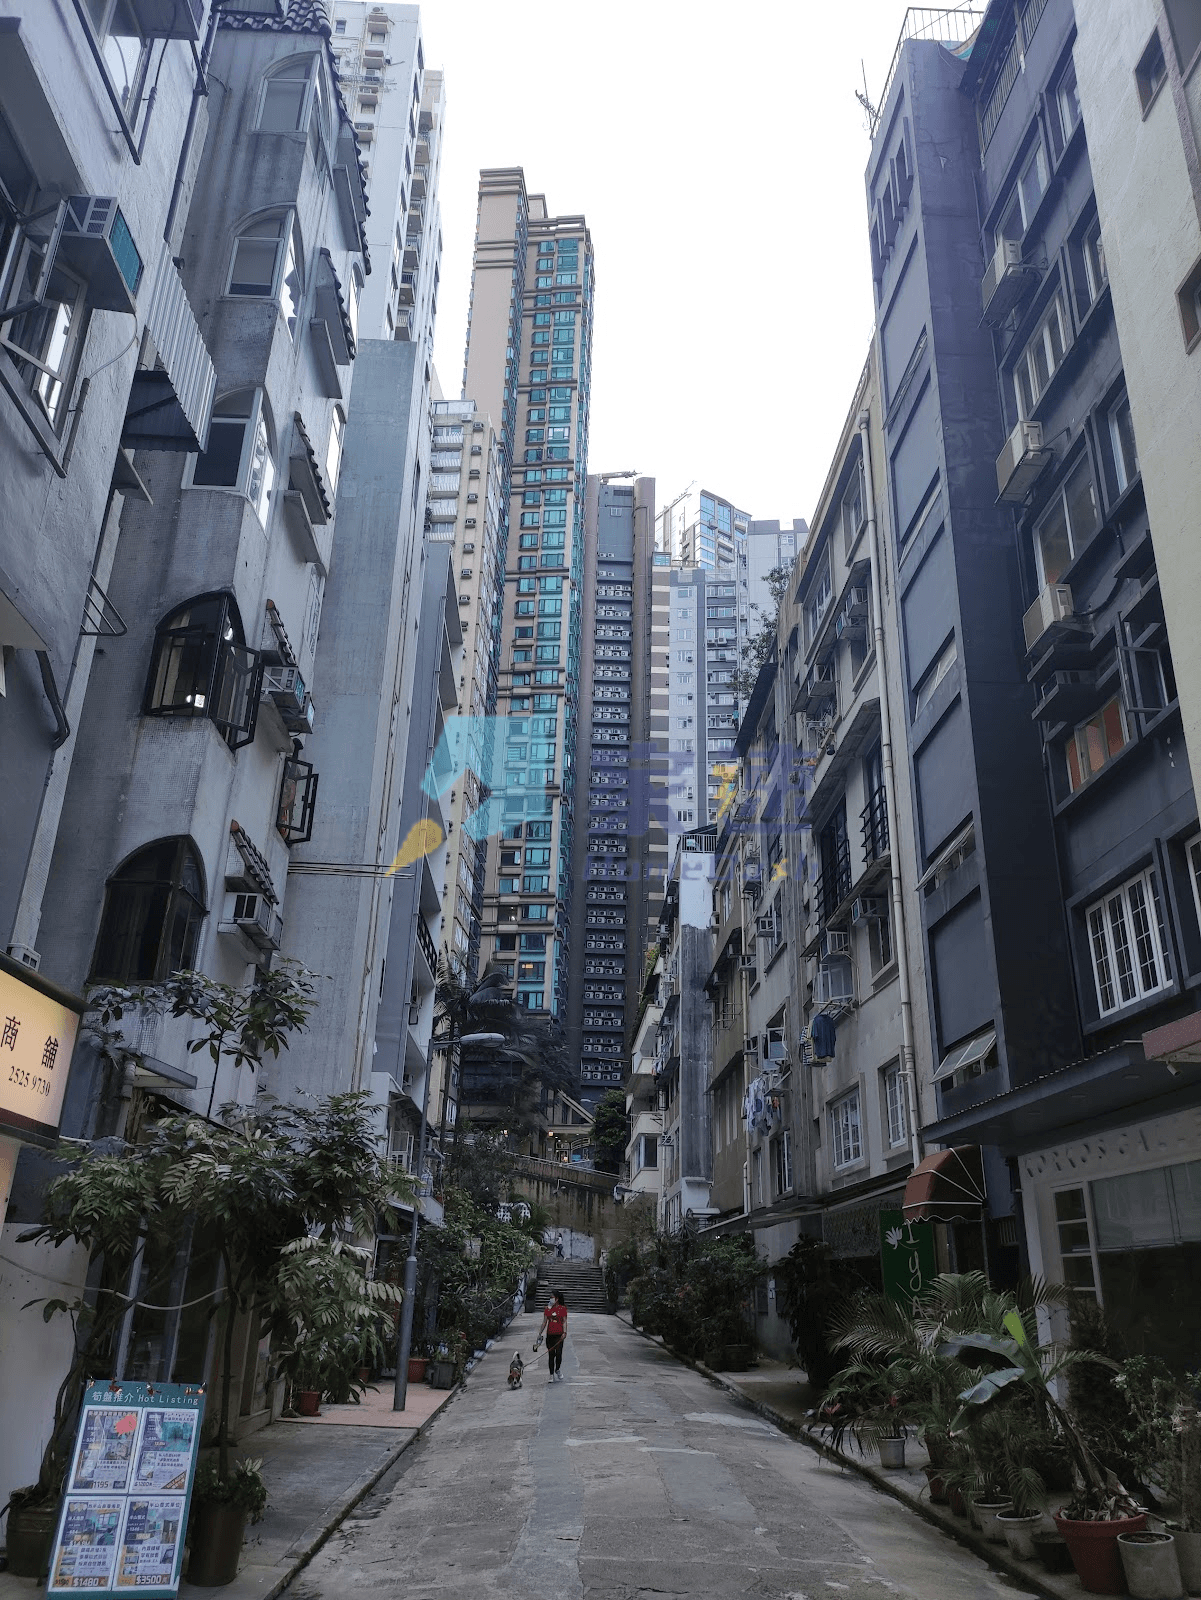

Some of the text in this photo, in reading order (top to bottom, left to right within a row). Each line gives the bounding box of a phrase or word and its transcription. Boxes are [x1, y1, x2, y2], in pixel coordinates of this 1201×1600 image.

[8, 1066, 51, 1097] 2525 9730
[91, 1391, 199, 1405] 筍盤推介 Hot Listing
[72, 1577, 99, 1587] $1480
[135, 1575, 161, 1585] $3500
